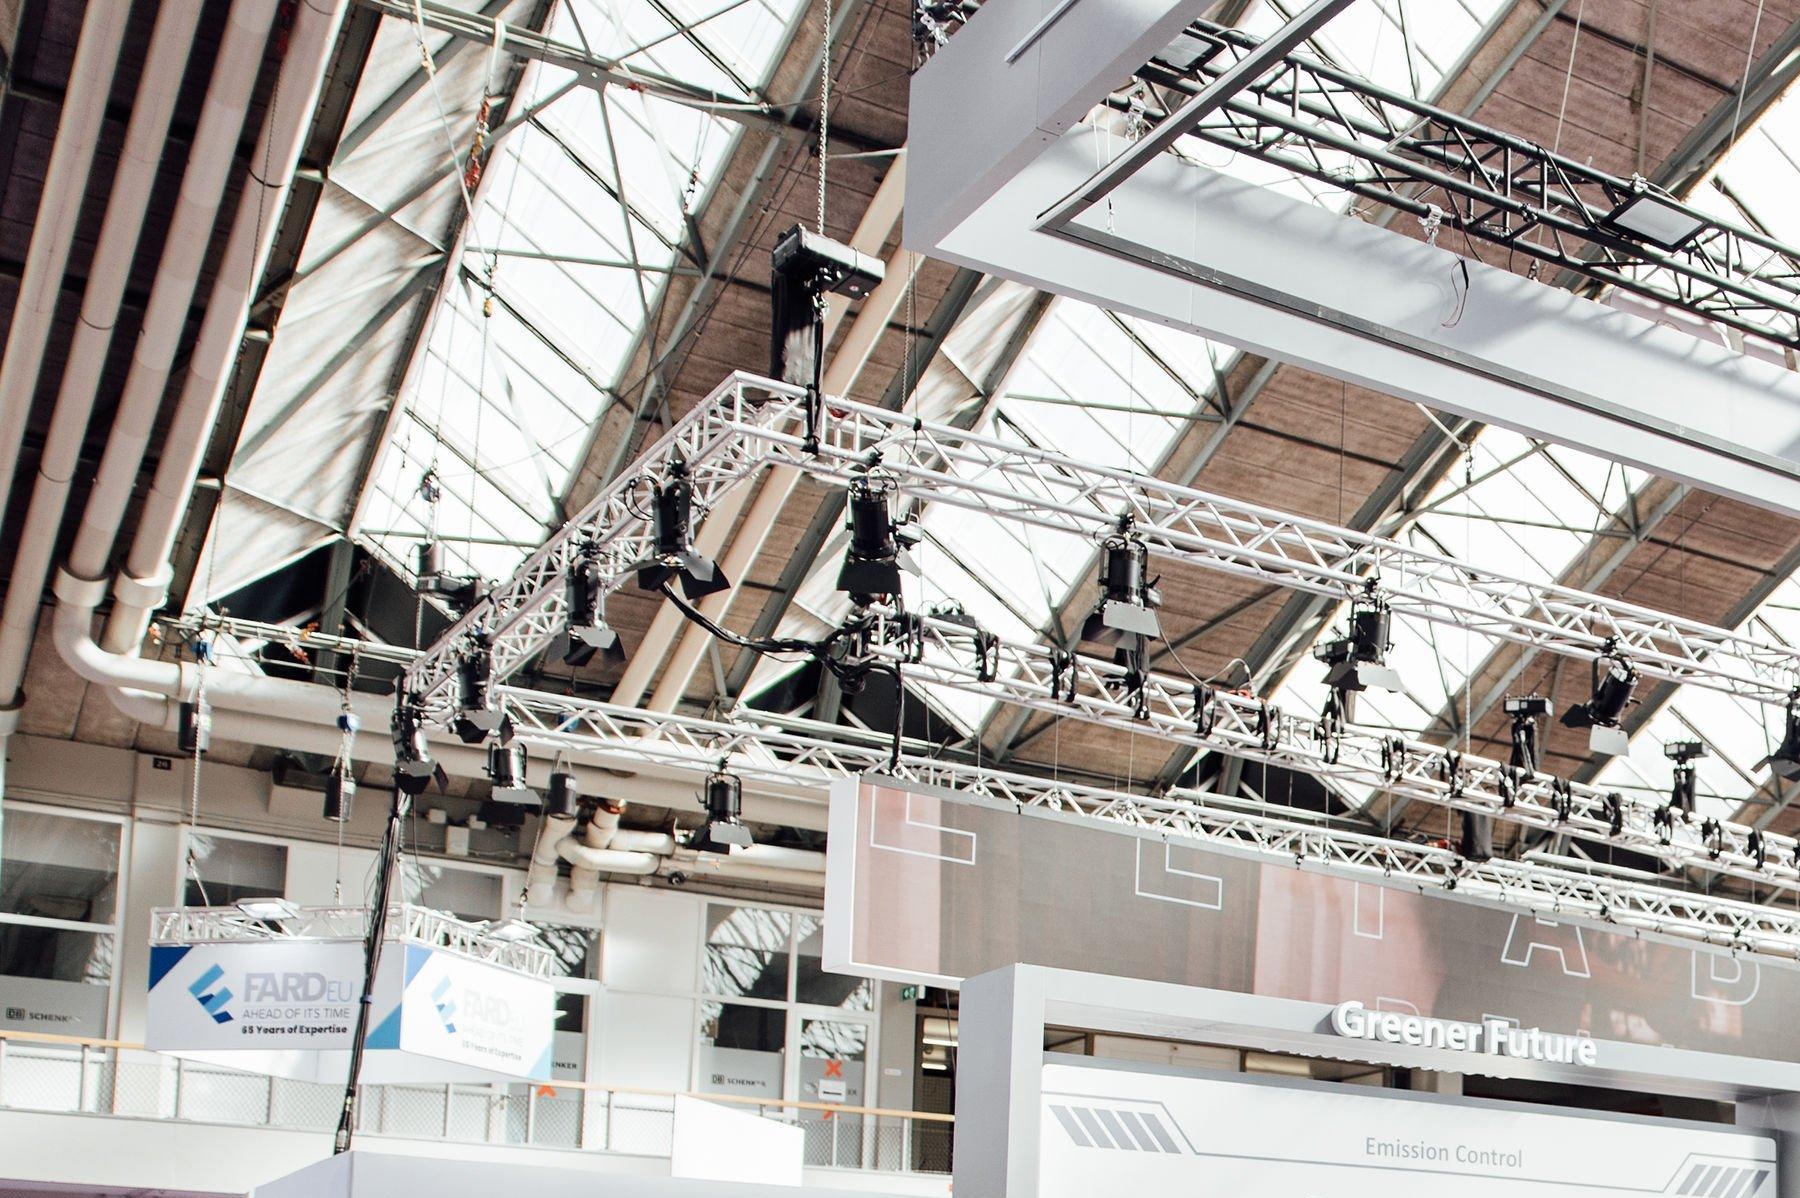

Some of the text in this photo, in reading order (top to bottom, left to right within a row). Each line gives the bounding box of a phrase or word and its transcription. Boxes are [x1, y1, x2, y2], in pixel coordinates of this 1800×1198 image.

[6, 1007, 26, 1020] DB
[242, 1007, 350, 1019] AHEAD OF ITS TIME
[256, 1025, 285, 1035] Years
[287, 1025, 298, 1034] of
[299, 1025, 348, 1036] Expertise
[1333, 1000, 1598, 1067] Greener Future
[551, 1061, 578, 1070] ENKER
[1365, 1136, 1523, 1168] Emission Control
